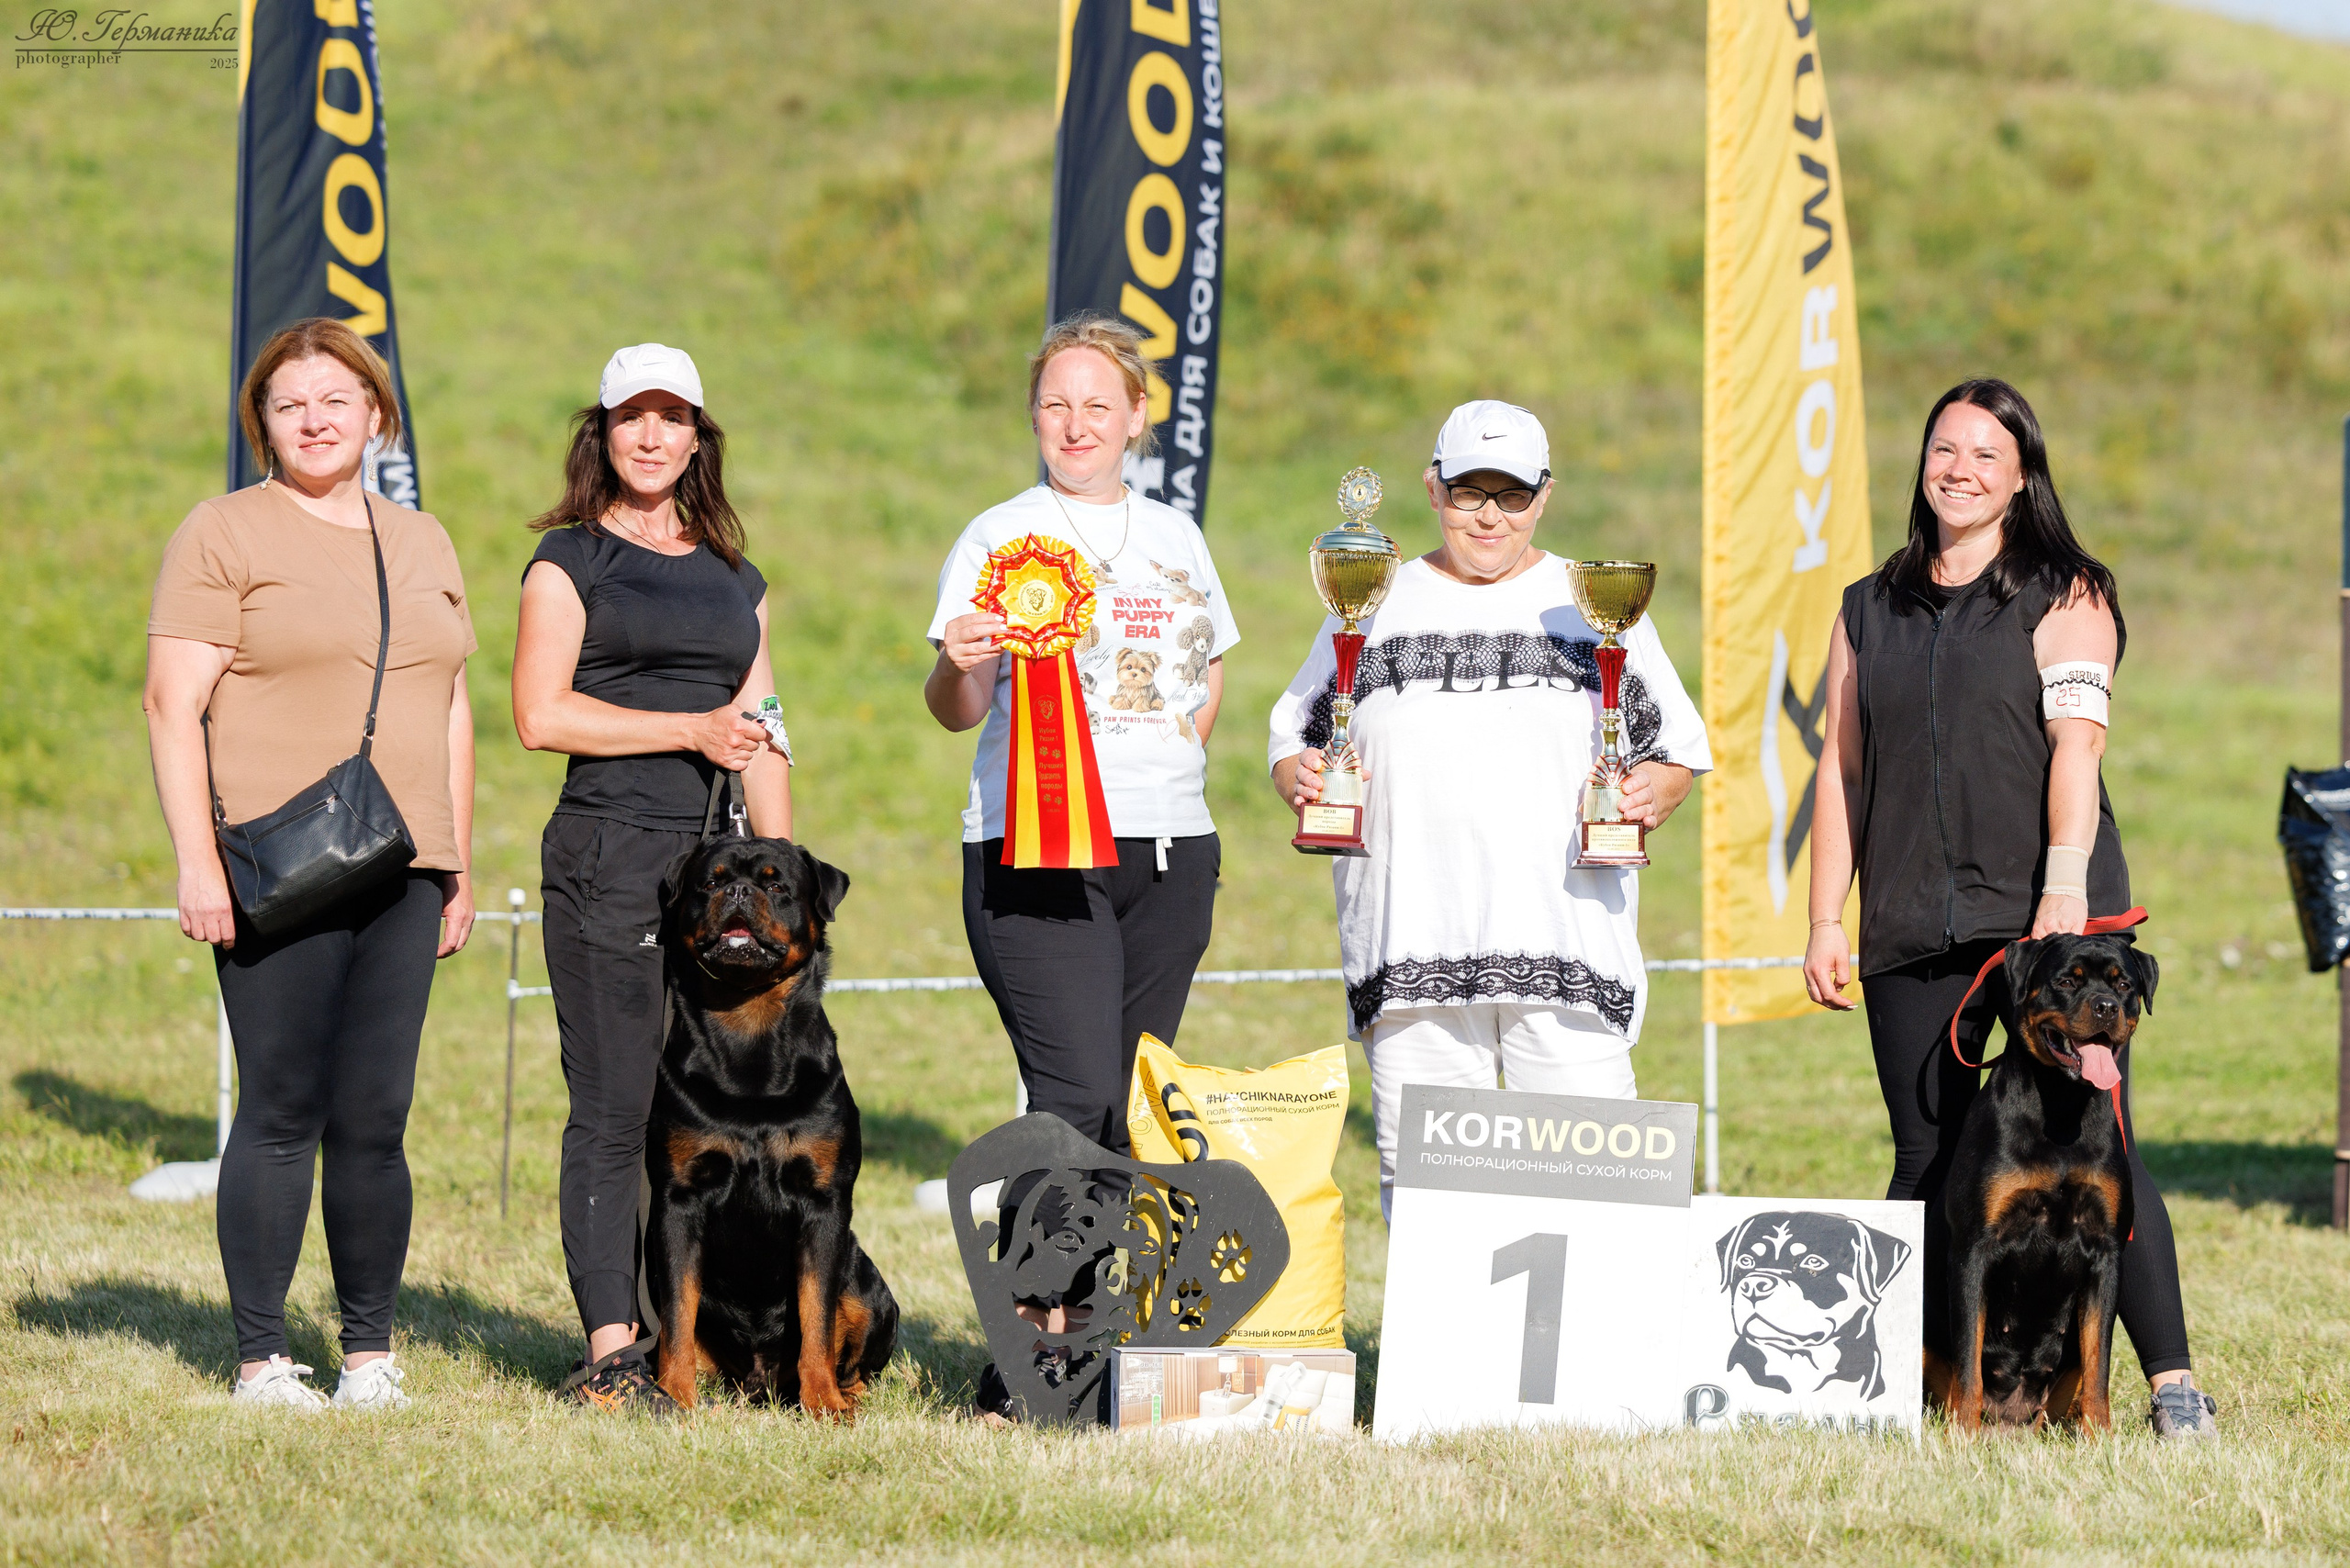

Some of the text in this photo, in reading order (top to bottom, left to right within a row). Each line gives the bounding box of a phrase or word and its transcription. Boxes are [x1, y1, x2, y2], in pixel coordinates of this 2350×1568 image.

[1197, 0, 1224, 129] КОШЕ
[1201, 138, 1223, 174] И
[1186, 182, 1222, 346] СОБАК
[1174, 354, 1208, 458] ДЛЯ
[1113, 597, 1163, 609] IN MY
[1112, 610, 1175, 623] PUPPY
[1125, 624, 1161, 639] ERA
[1076, 644, 1114, 670] Lovely
[2068, 670, 2101, 682] SIRIUS
[2055, 687, 2081, 707] 25
[1287, 1105, 1315, 1114] СУХОЙ
[1315, 1103, 1340, 1111] КОРМ
[1422, 1109, 1678, 1161] KORWOOD
[1419, 1151, 1673, 1182] ПОЛНОРАЦИОННЫЙ СУХОЙ КОРМ
[1489, 1231, 1569, 1406] 1
[1224, 1326, 1337, 1338] ОЛЕЗНЫЙ КОРМ ДЛЯ СОБАК
